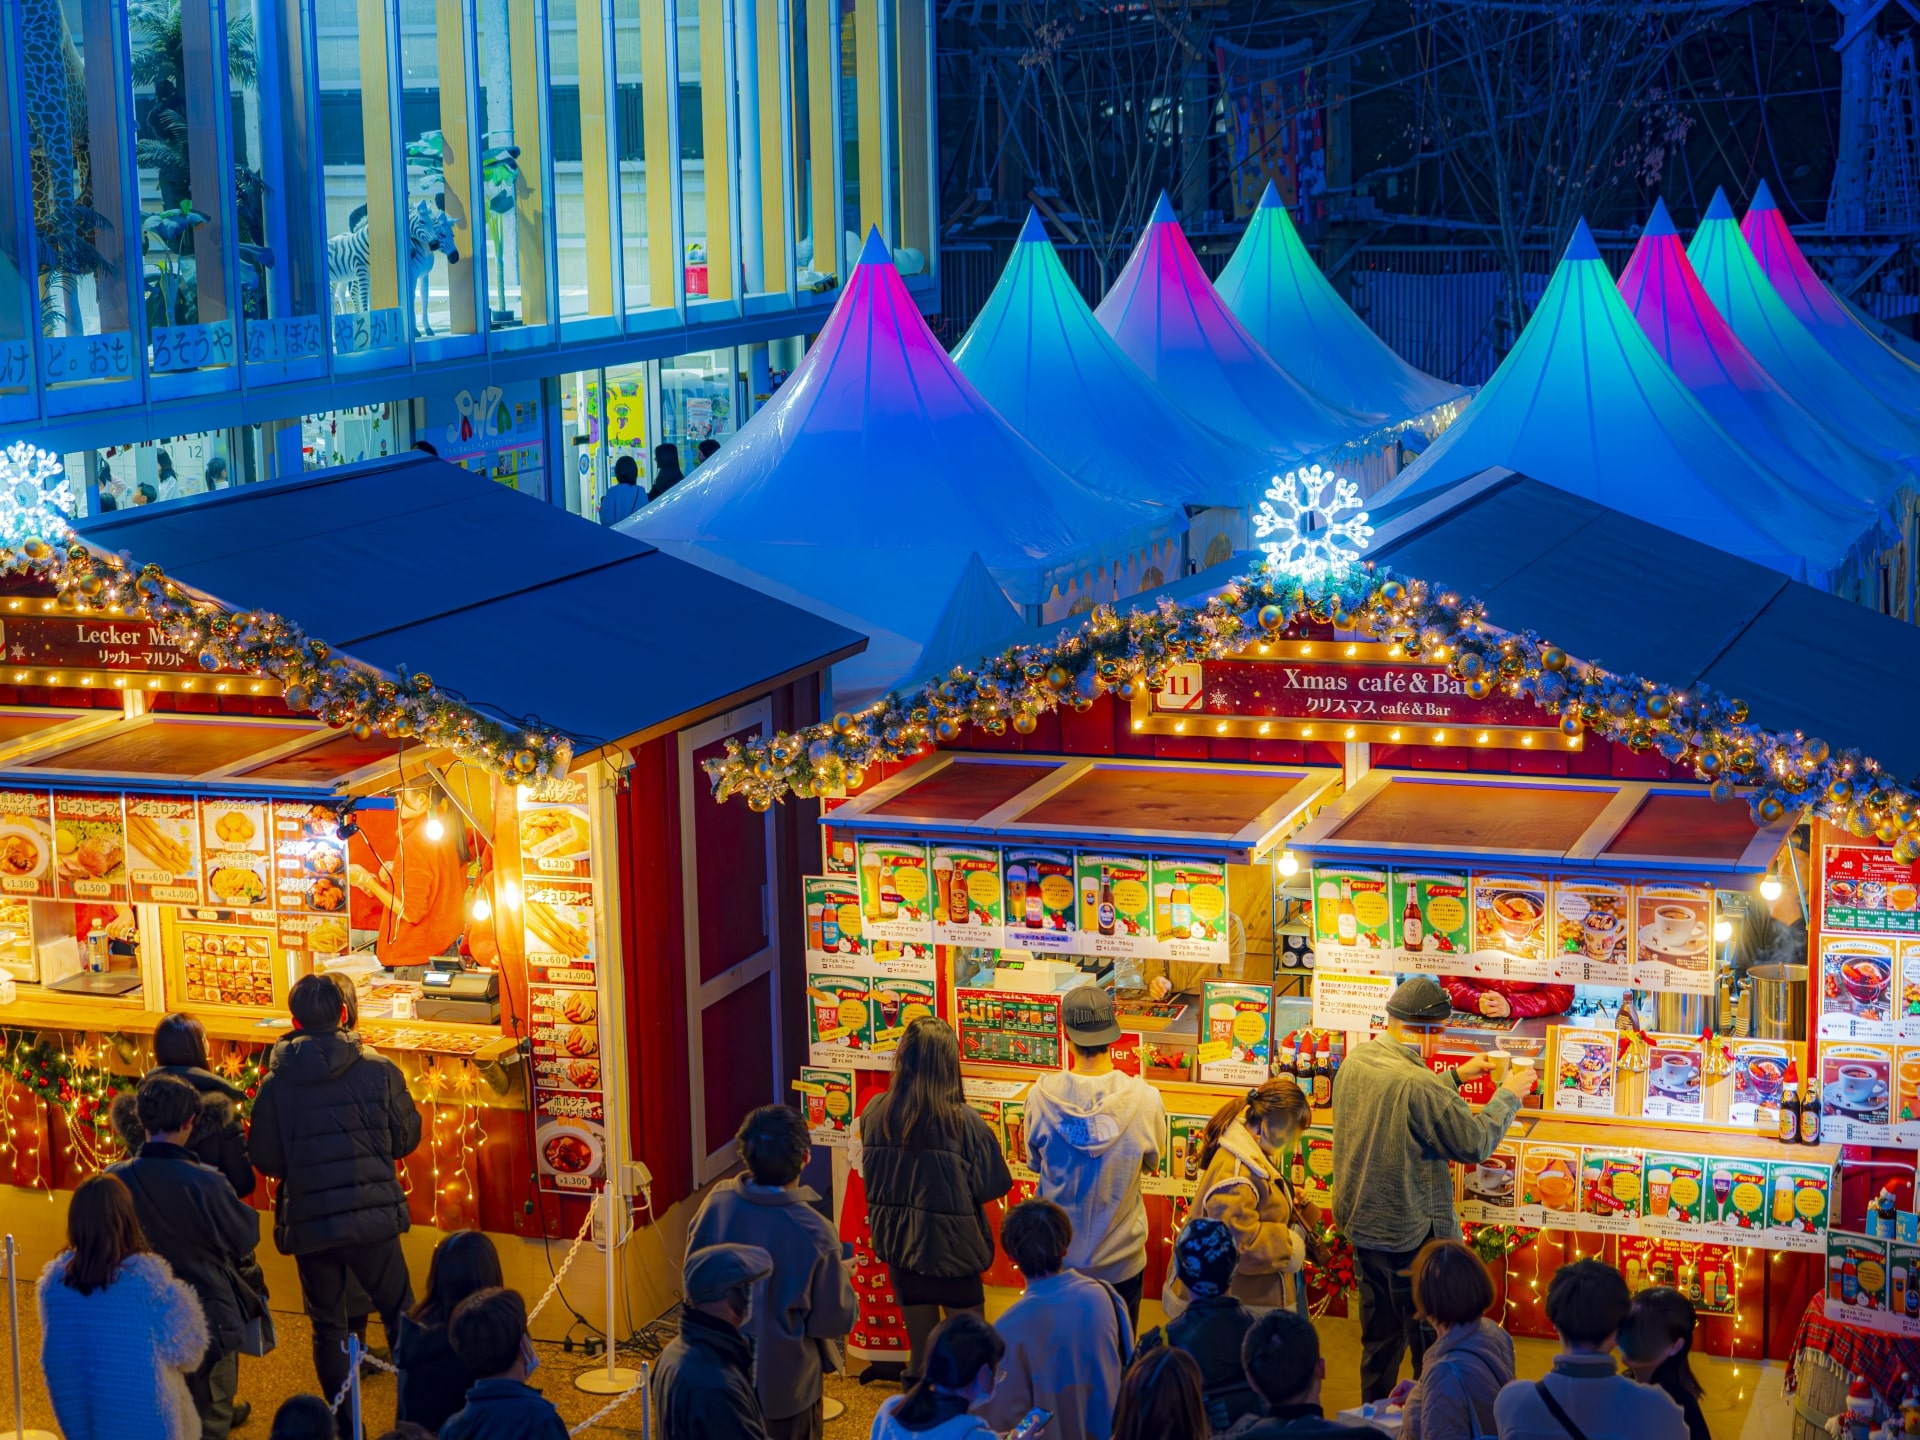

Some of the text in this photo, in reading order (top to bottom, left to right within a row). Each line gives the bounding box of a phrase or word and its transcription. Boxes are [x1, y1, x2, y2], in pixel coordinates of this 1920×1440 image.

[188, 445, 203, 459] 12
[77, 624, 141, 646] Lecker
[98, 650, 185, 667] リッカーマルクト
[1168, 676, 1191, 696] 11
[1283, 668, 1348, 691] Xmas
[1306, 698, 1377, 715] クリスマス
[60, 801, 116, 814] ローストビーフ
[142, 803, 179, 814] チュロス
[541, 859, 571, 869] ¥1,200
[541, 890, 578, 902] チュロス
[255, 912, 275, 920] ¥1,50
[545, 956, 567, 965] ¥600
[564, 970, 591, 981] ¥1,000
[553, 1097, 588, 1107] ボルシチ
[1594, 1193, 1619, 1207] SOLD OUT
